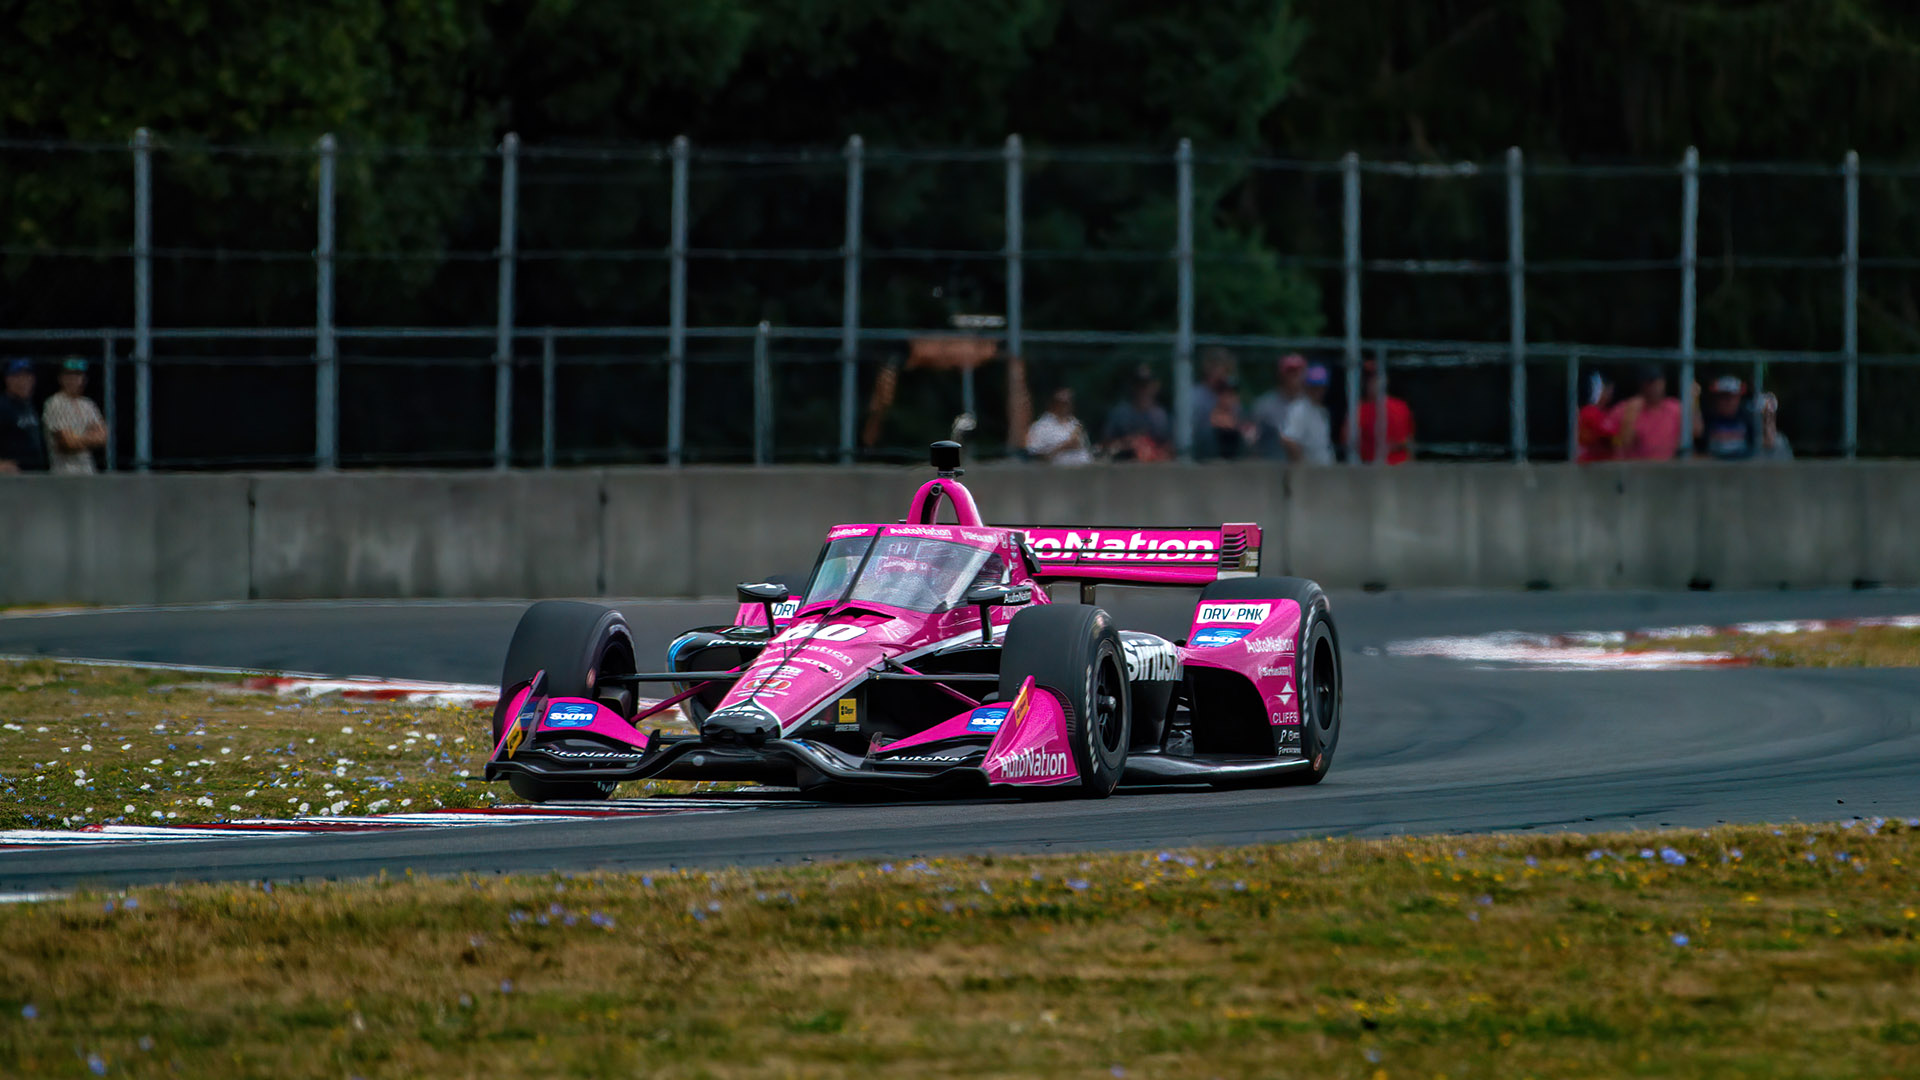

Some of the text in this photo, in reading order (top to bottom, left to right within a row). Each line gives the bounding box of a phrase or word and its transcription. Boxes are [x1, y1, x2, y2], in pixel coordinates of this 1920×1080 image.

[889, 527, 953, 537] AutoNation
[1024, 530, 1214, 560] toNation
[1202, 608, 1264, 620] DRV PNK
[1243, 636, 1295, 653] AutoNation
[1272, 711, 1299, 724] CLIFFS
[1000, 747, 1068, 777] AutoNation
